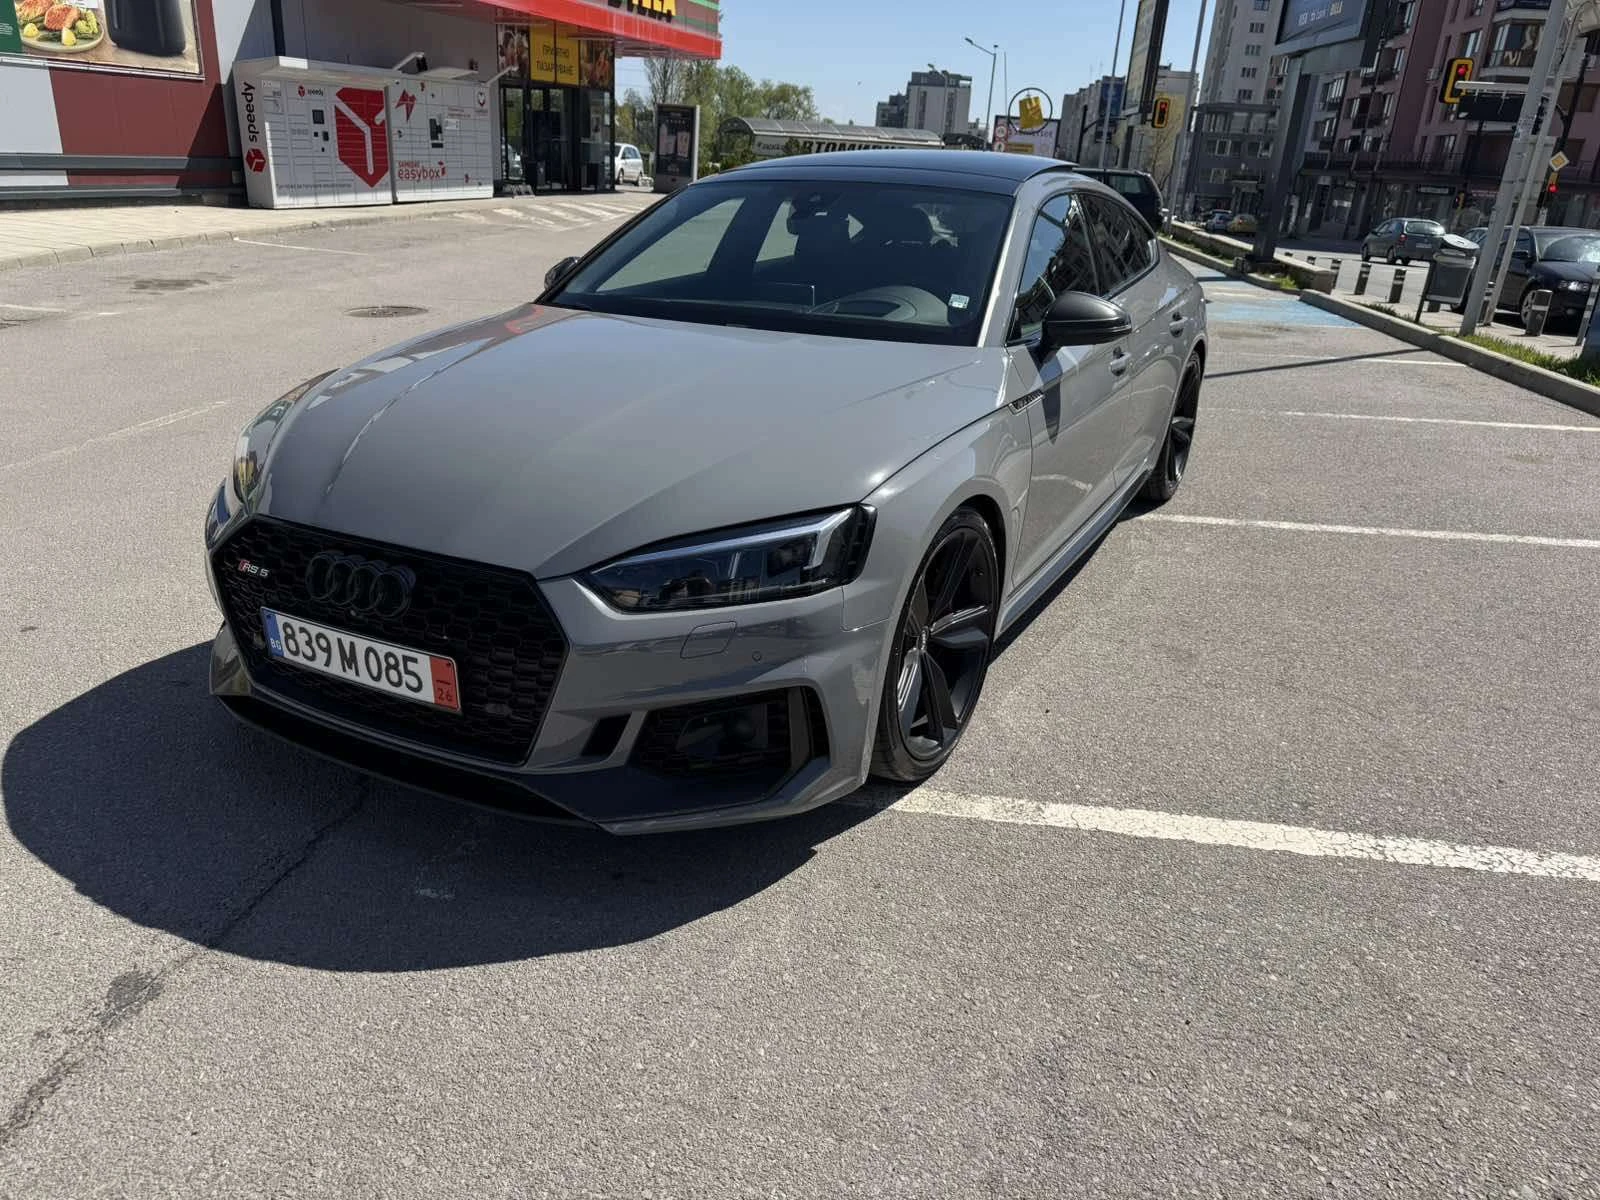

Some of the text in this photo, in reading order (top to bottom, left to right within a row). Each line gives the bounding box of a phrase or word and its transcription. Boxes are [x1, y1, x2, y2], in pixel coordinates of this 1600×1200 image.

[542, 44, 570, 58] ПРИТНО
[535, 61, 574, 76] ПАЗАРВАНЕ
[241, 81, 260, 142] speedy
[398, 166, 440, 182] easybox
[270, 638, 282, 650] BG
[282, 622, 423, 693] 839 M 085
[437, 687, 452, 702] 26
